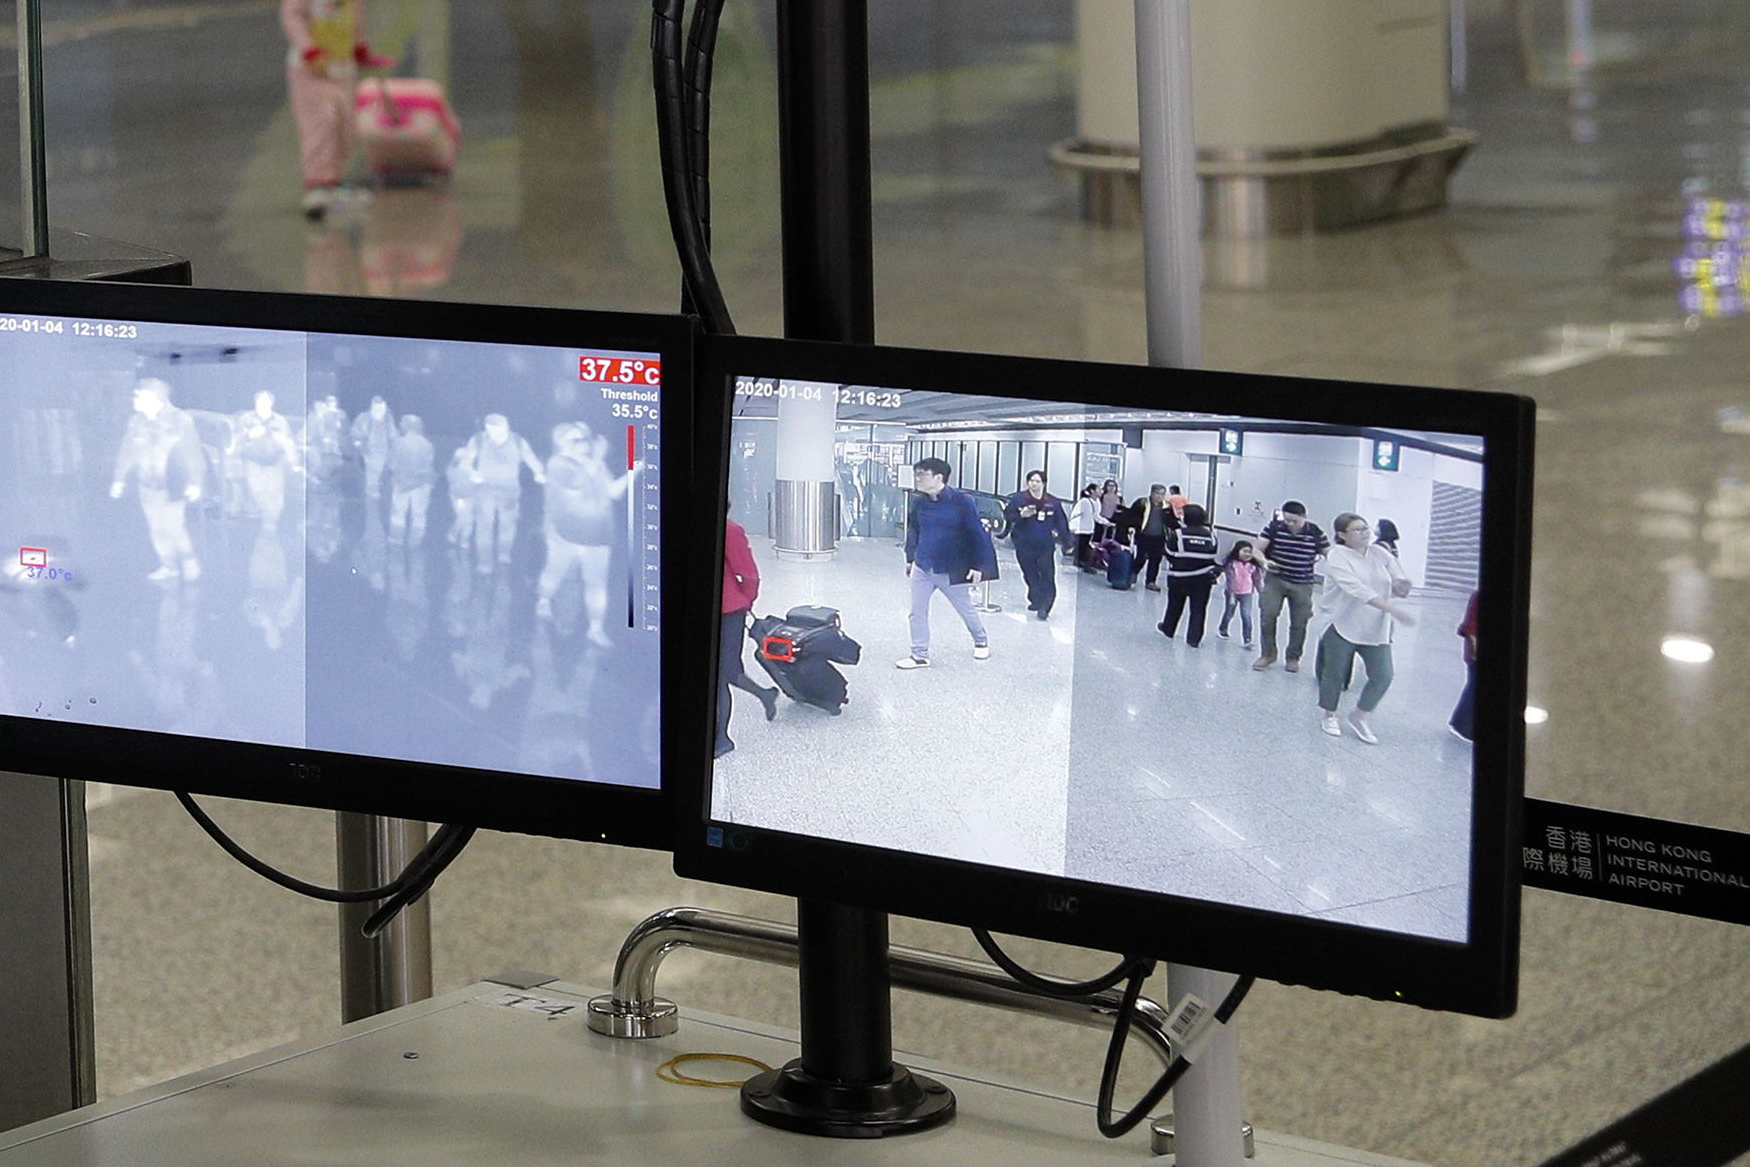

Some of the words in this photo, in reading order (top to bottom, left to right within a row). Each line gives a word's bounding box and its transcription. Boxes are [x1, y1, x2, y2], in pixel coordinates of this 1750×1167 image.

[71, 322, 138, 340] 12:16:23
[600, 387, 659, 403] Threshold
[735, 380, 823, 403] 2020-01-04
[832, 389, 903, 409] 12:16:23
[1545, 825, 1593, 855] 香港
[1605, 835, 1657, 854] HONG
[1661, 844, 1713, 864] KONG
[1607, 853, 1750, 889] INTERNATIONAL
[1608, 872, 1686, 897] AIRPORT
